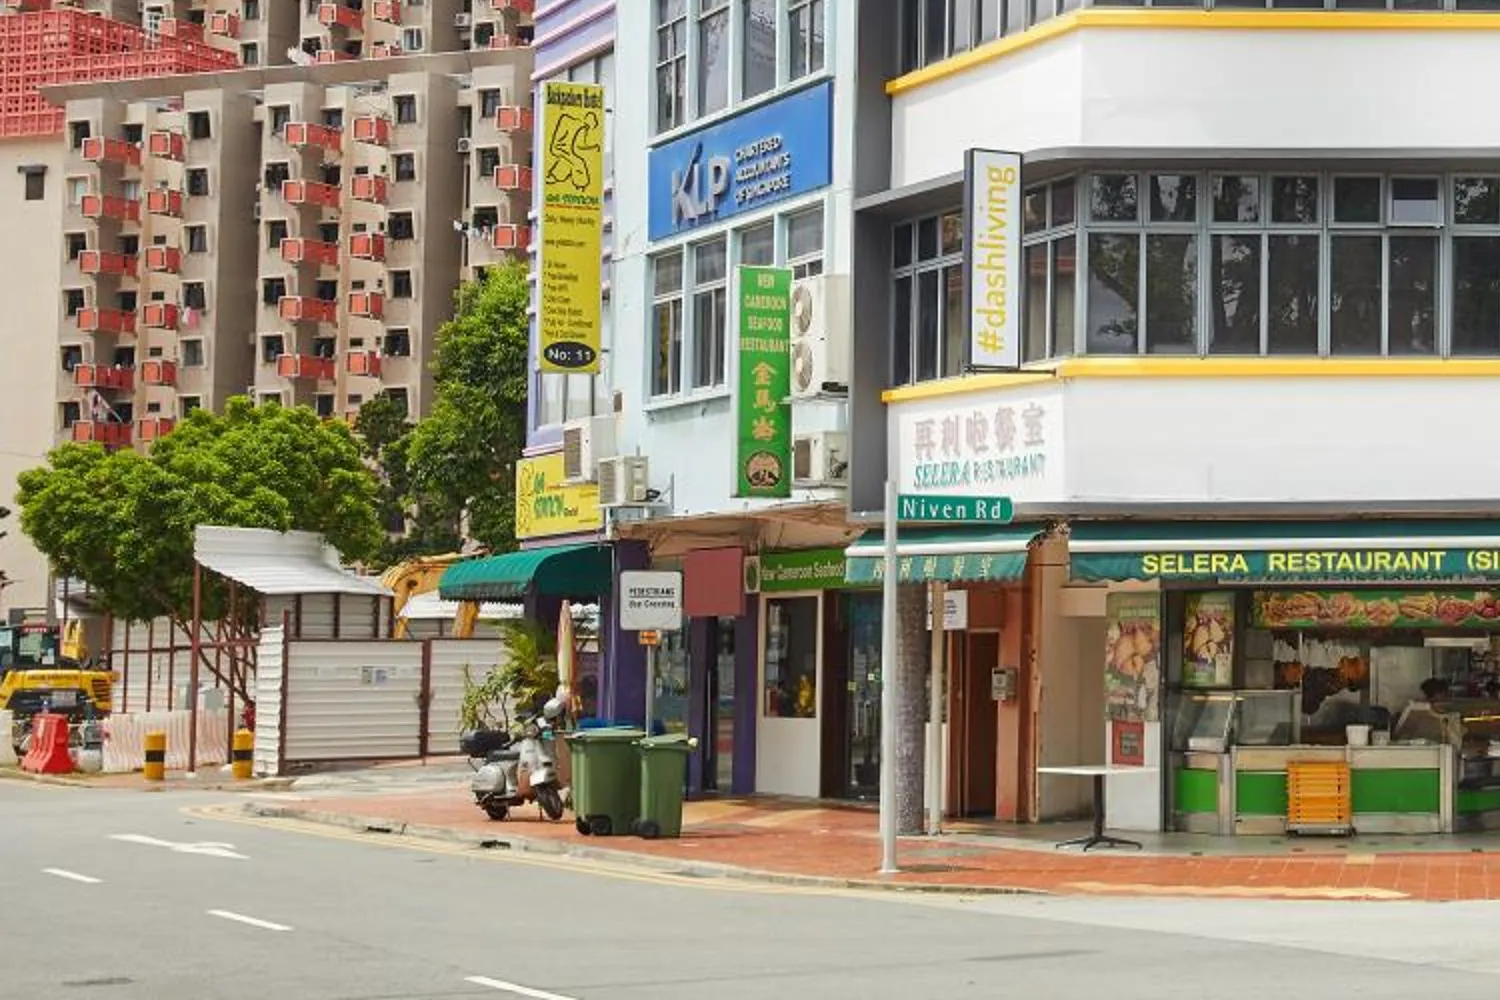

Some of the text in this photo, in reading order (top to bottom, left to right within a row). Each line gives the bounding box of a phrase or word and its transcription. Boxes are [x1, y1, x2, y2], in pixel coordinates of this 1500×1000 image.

[976, 164, 1016, 354] #dashliving
[548, 349, 591, 361] No: 11
[913, 452, 1046, 490] SELERA RESTAURANT
[902, 498, 1001, 519] Niven Rd
[1142, 552, 1249, 574] SELERA
[1268, 550, 1447, 572] RESTAURANT
